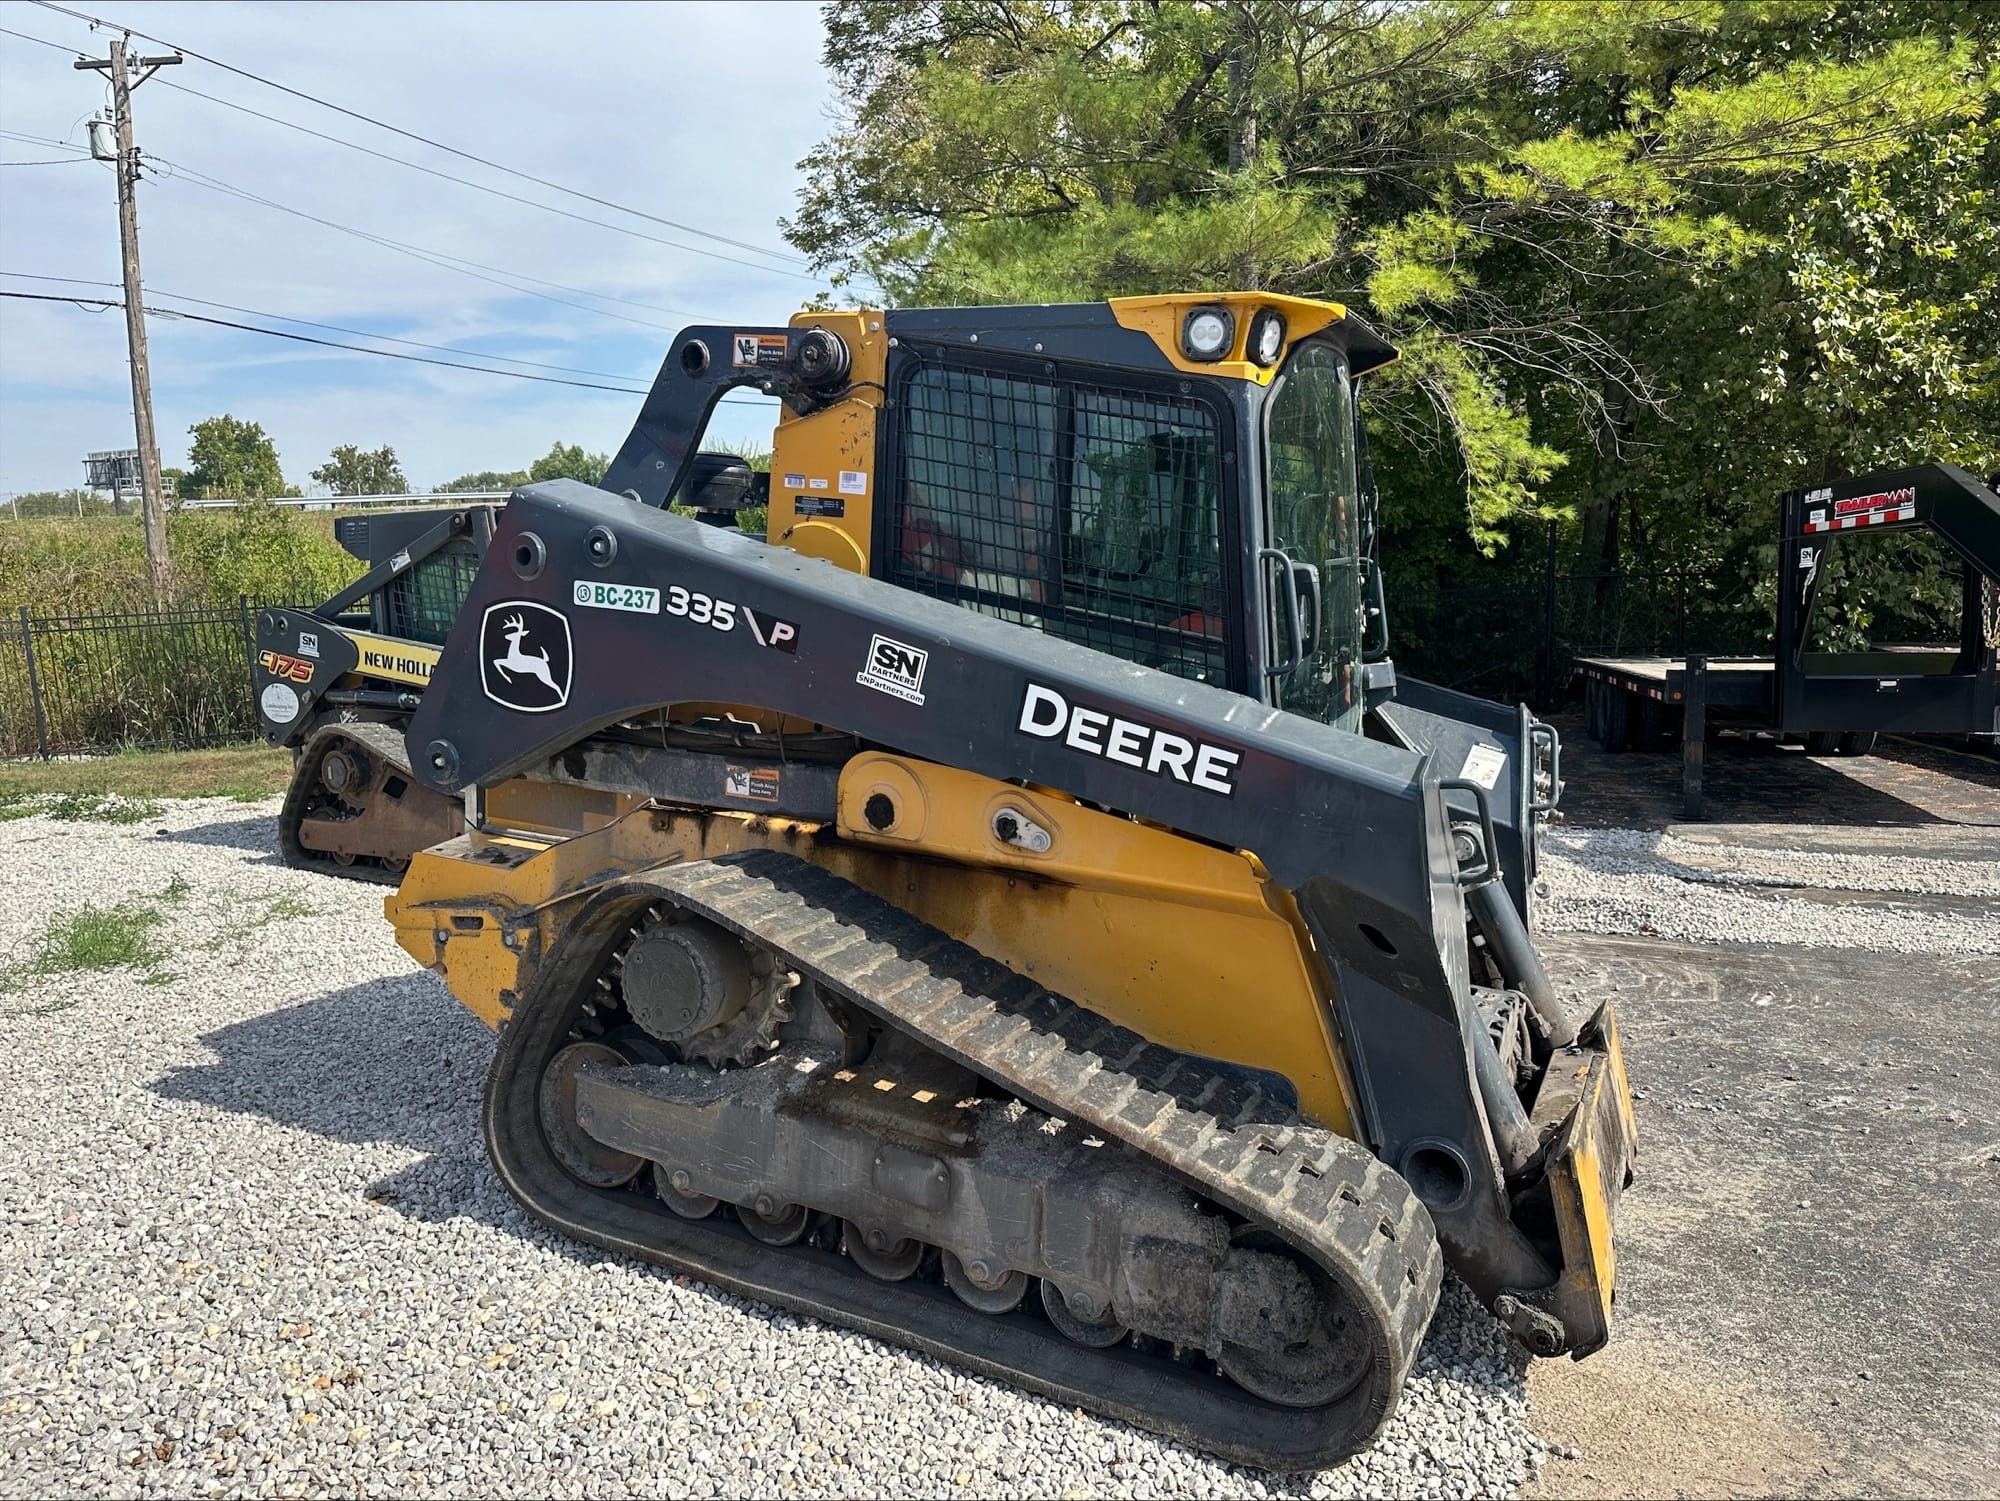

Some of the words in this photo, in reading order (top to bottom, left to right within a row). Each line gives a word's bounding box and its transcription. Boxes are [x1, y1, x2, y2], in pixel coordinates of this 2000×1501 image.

[1836, 488, 1914, 513] TRAILERMAN
[594, 585, 655, 609] BC-237
[666, 585, 736, 632] 335
[769, 621, 795, 645] P
[260, 651, 313, 681] C175
[364, 651, 394, 671] NEW
[858, 674, 923, 704] SNPartners.com
[872, 665, 916, 687] PARTNERS
[1018, 683, 1240, 795] DEERE
